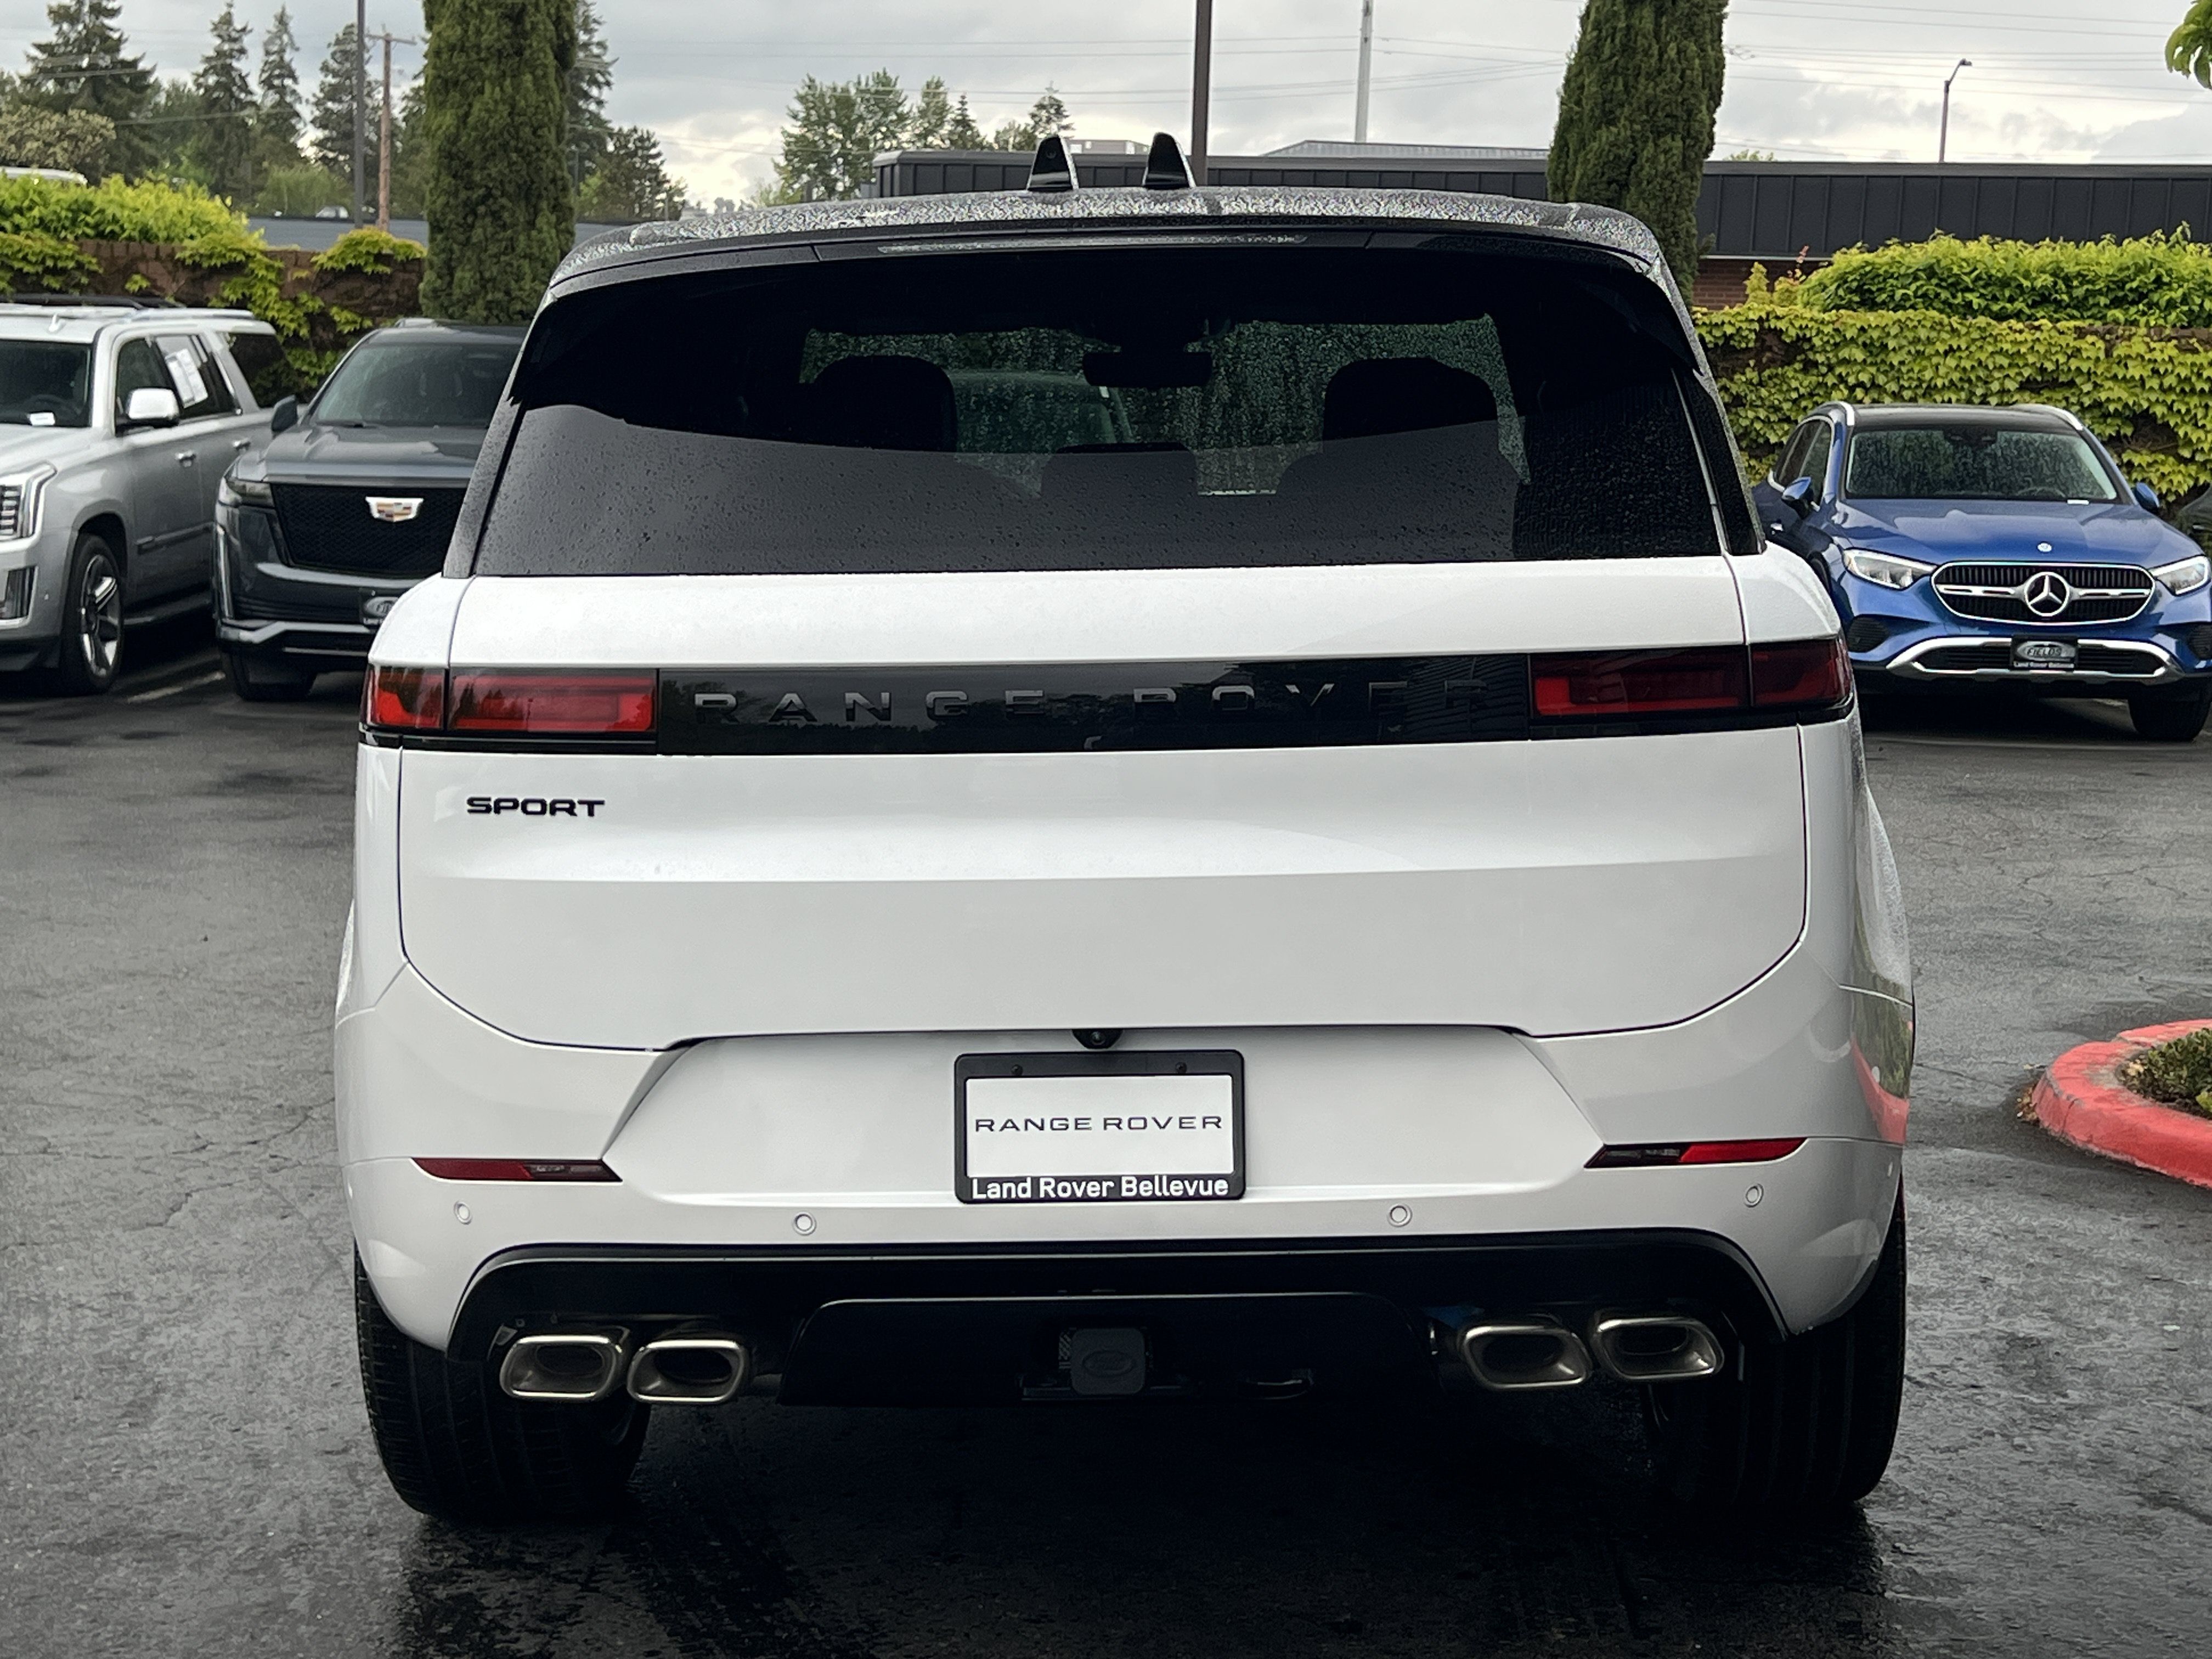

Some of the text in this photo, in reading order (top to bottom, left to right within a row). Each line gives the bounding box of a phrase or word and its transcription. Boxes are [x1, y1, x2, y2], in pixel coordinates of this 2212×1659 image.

[693, 689, 1044, 725] RANGE
[466, 796, 606, 817] SPORT
[975, 1116, 1222, 1132] RANGE ROVER
[972, 1174, 1229, 1199] Land Rover Bellevue
